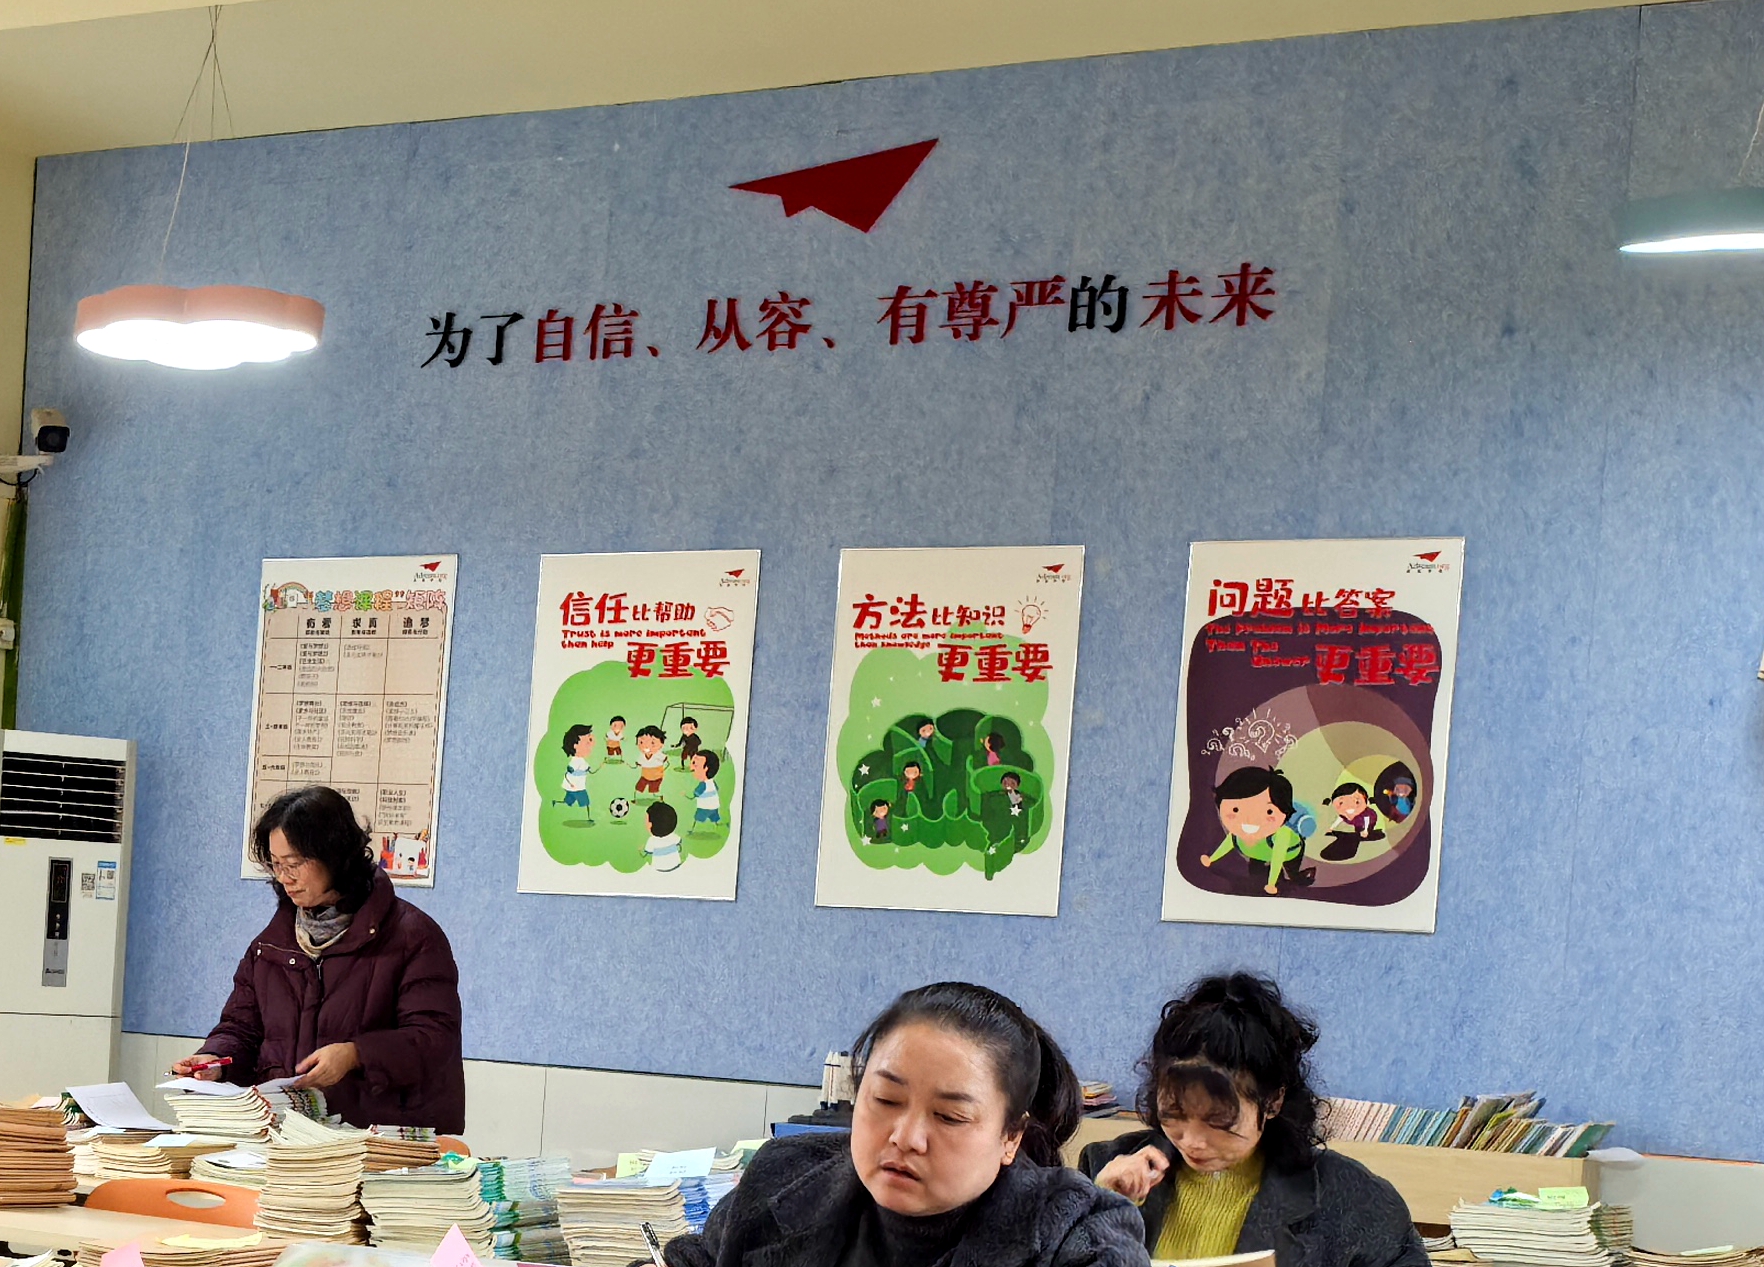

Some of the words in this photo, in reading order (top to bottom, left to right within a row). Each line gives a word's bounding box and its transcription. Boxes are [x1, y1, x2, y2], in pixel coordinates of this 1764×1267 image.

[420, 262, 1277, 370] 为了自信、从容、有尊严的未来
[559, 590, 696, 627] 信任比帮助
[852, 593, 1006, 630] 方法比知识
[1207, 577, 1396, 618] 问题比答案
[561, 629, 596, 639] Trust
[600, 629, 611, 638] is
[614, 630, 642, 638] more
[646, 628, 707, 640] important
[626, 641, 731, 679] 更重要
[937, 642, 1054, 683] 更重要
[1313, 642, 1441, 686] 更重要
